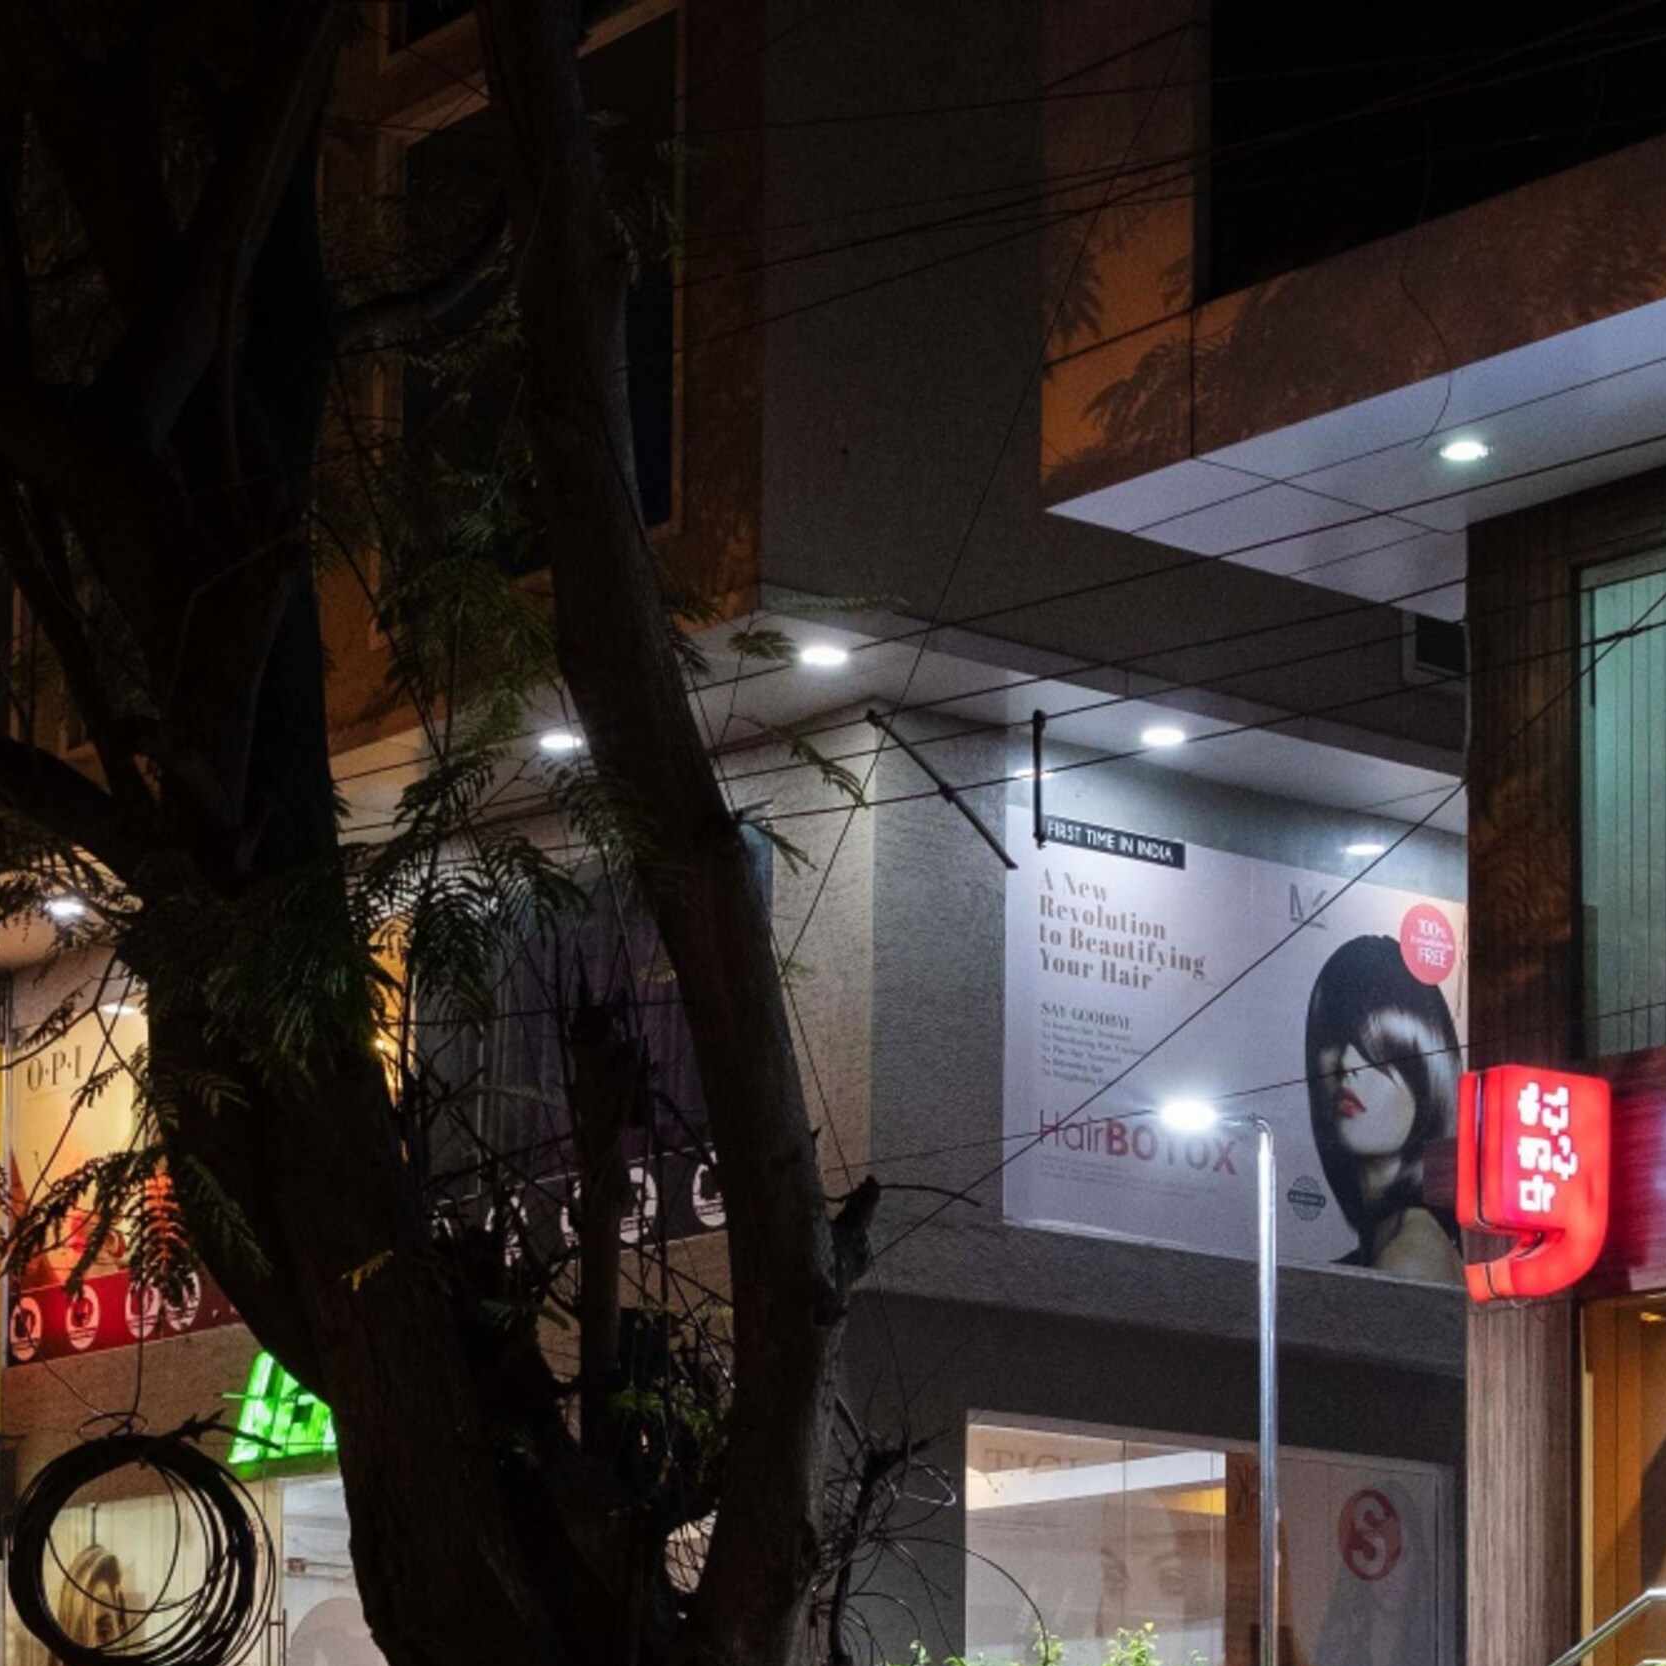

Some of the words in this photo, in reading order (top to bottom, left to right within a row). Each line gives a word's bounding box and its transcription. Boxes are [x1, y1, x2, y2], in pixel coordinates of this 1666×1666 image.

[1047, 820, 1081, 842] FIRST
[1085, 828, 1116, 850] TIME
[1119, 836, 1134, 855] IN
[1136, 840, 1174, 863] INDIA
[1063, 871, 1107, 902] New
[1039, 893, 1167, 941] Revolution
[1039, 921, 1062, 946] to
[1069, 926, 1207, 982] Beautifying
[1039, 947, 1094, 980] Your
